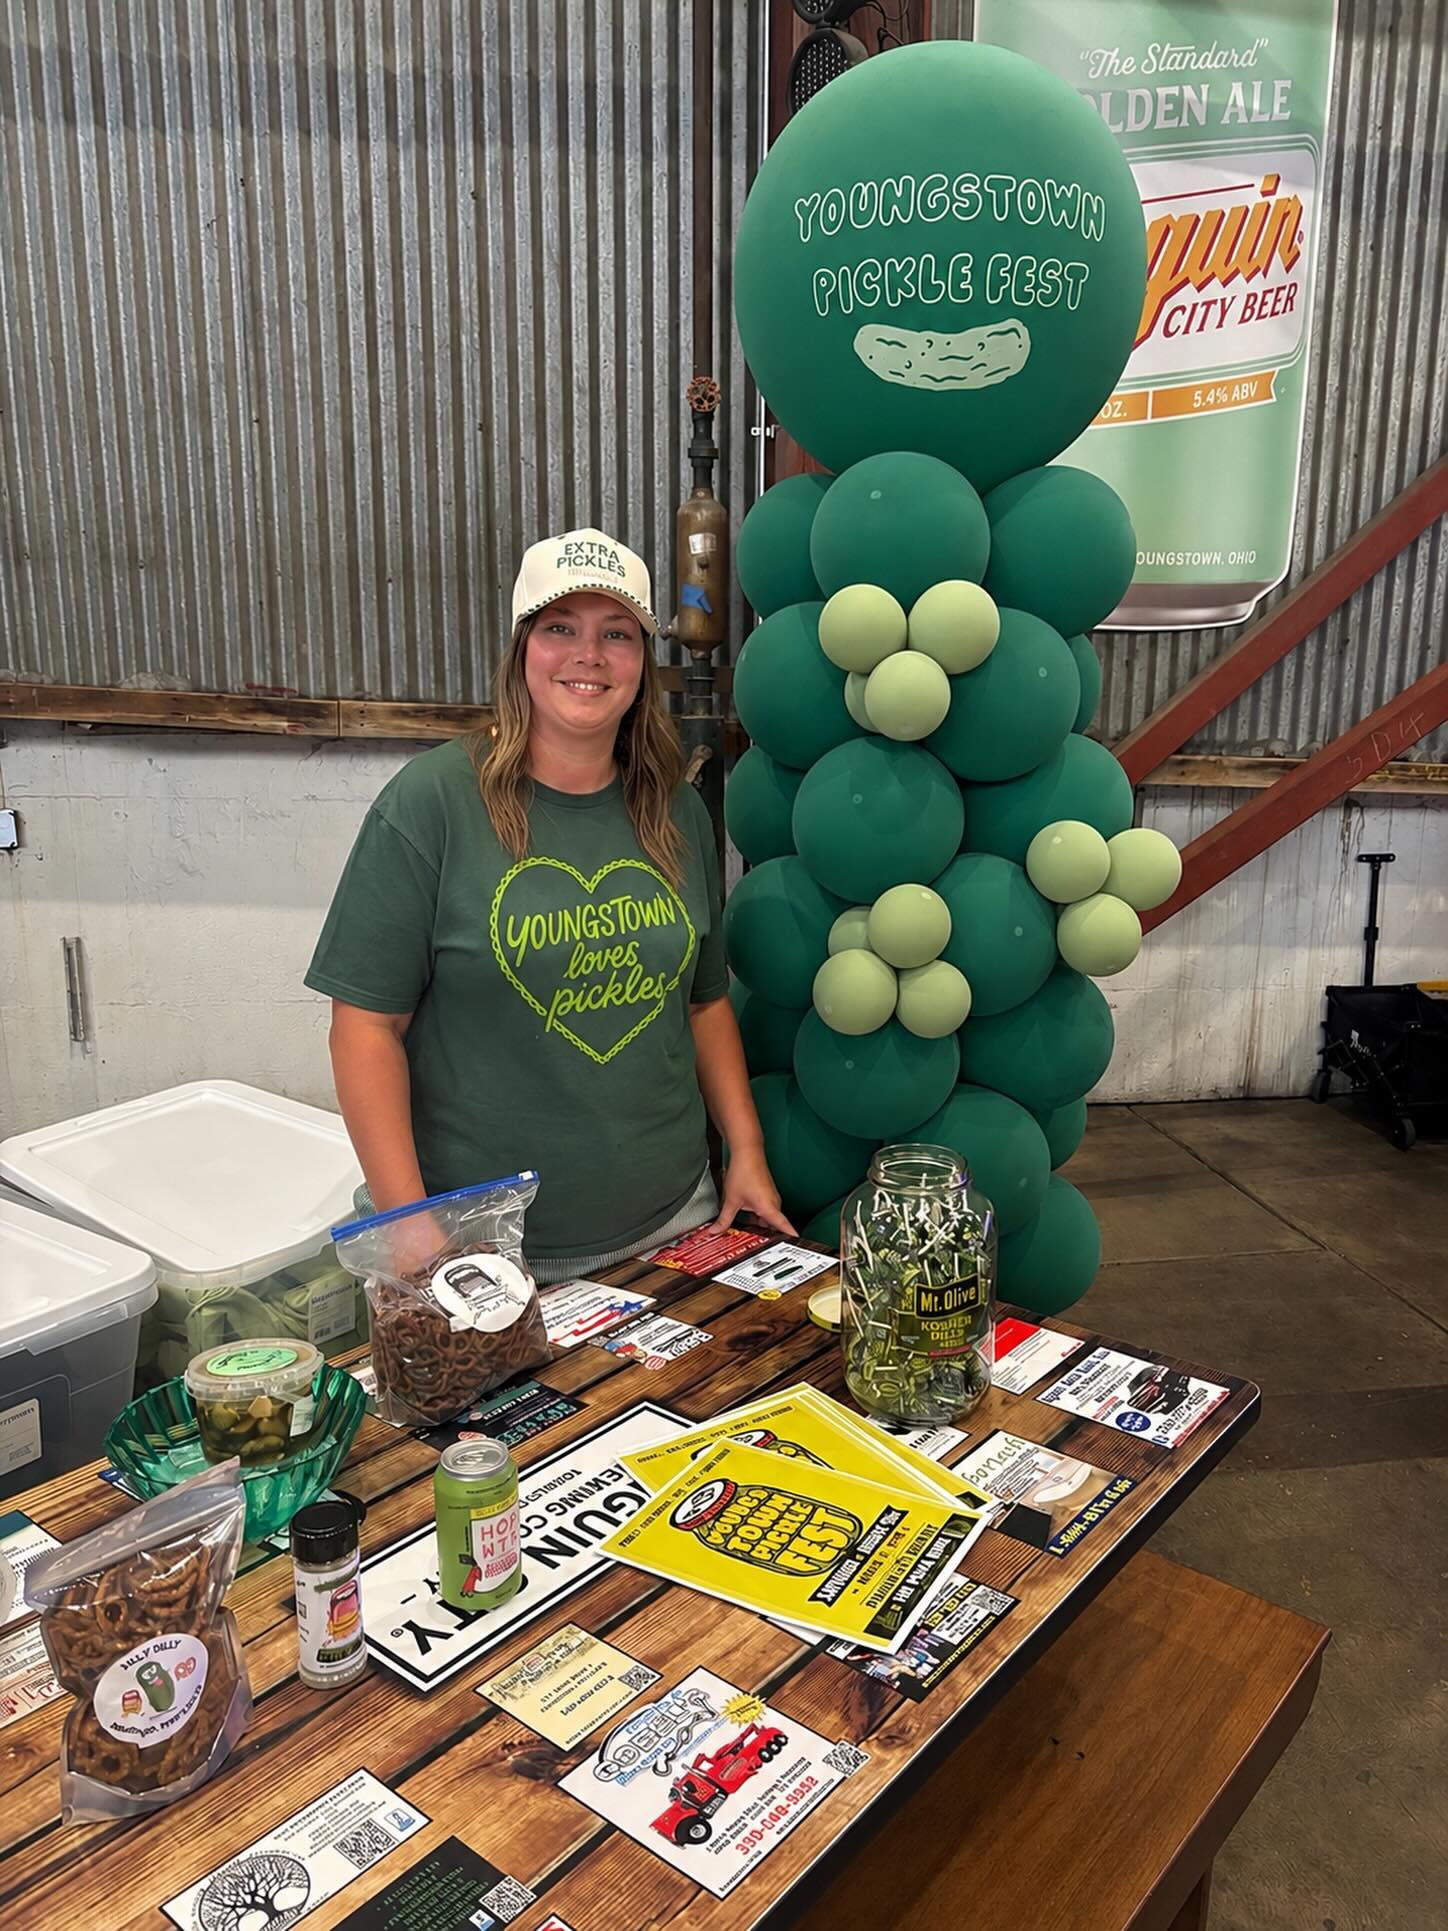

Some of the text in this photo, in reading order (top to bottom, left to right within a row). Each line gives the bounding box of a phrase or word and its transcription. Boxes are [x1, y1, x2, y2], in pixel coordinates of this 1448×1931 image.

[1080, 79, 1293, 134] LDEN ALE
[795, 173, 1105, 242] YOUNGSTOWN
[812, 253, 1090, 317] PICKLE FEST
[1162, 282, 1299, 339] CITY BEER
[1192, 389, 1228, 408] 5.4%
[1231, 380, 1259, 401] ABV
[556, 555, 626, 578] PICKLES
[564, 541, 620, 563] EXTRA
[1228, 550, 1257, 565] OHIO
[506, 892, 676, 967] YOUNGSTOWN
[563, 941, 640, 979] loves
[545, 963, 666, 1032] pickles
[921, 1290, 942, 1312] Mt.
[944, 1286, 976, 1310] Olive
[480, 1511, 517, 1542] HOP
[775, 1506, 855, 1572] FEST
